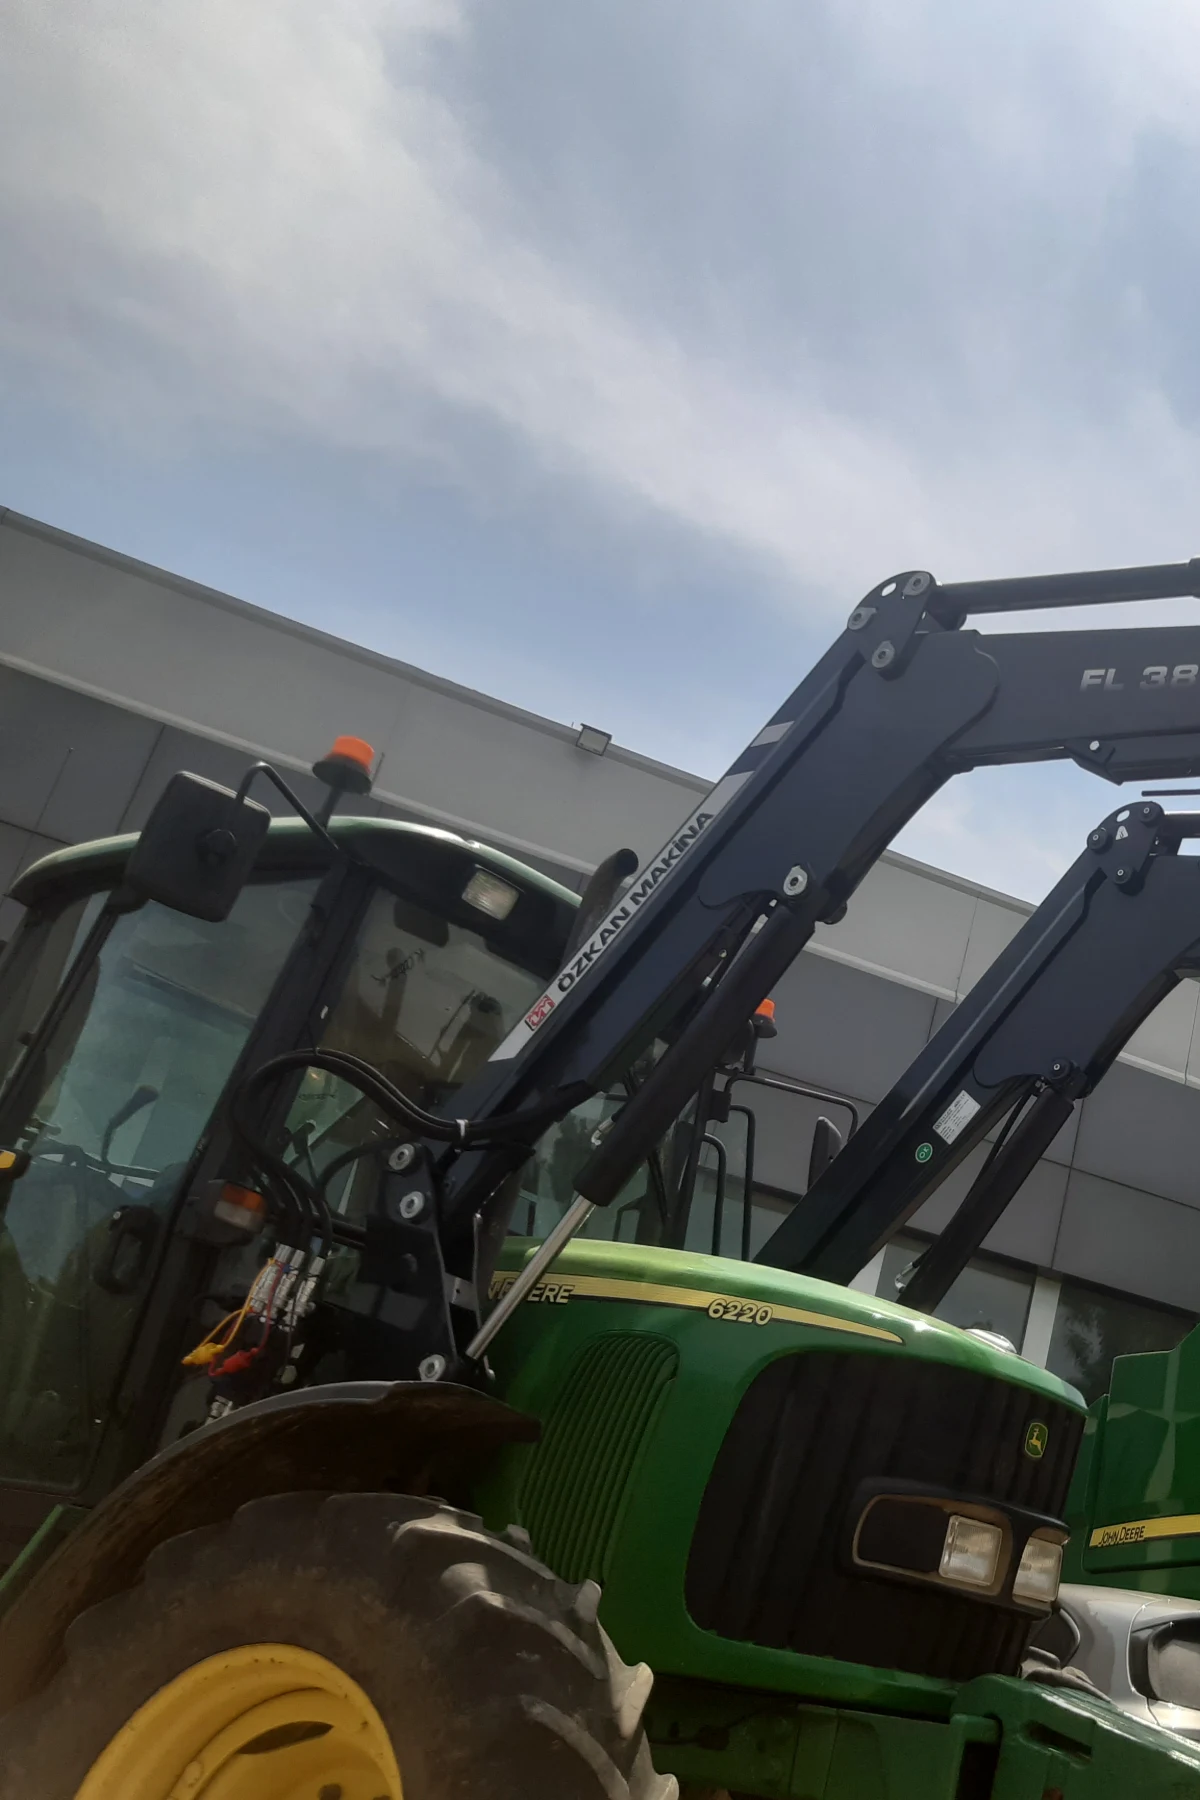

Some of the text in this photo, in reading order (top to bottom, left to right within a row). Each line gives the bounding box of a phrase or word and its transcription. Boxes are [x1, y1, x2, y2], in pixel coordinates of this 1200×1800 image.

[1079, 668, 1125, 692] FL
[557, 811, 715, 993] ÖZKAN MAKİNA
[918, 1146, 930, 1159] OK
[707, 1298, 774, 1326] 6220
[1098, 1525, 1146, 1545] JOHN DEERE
